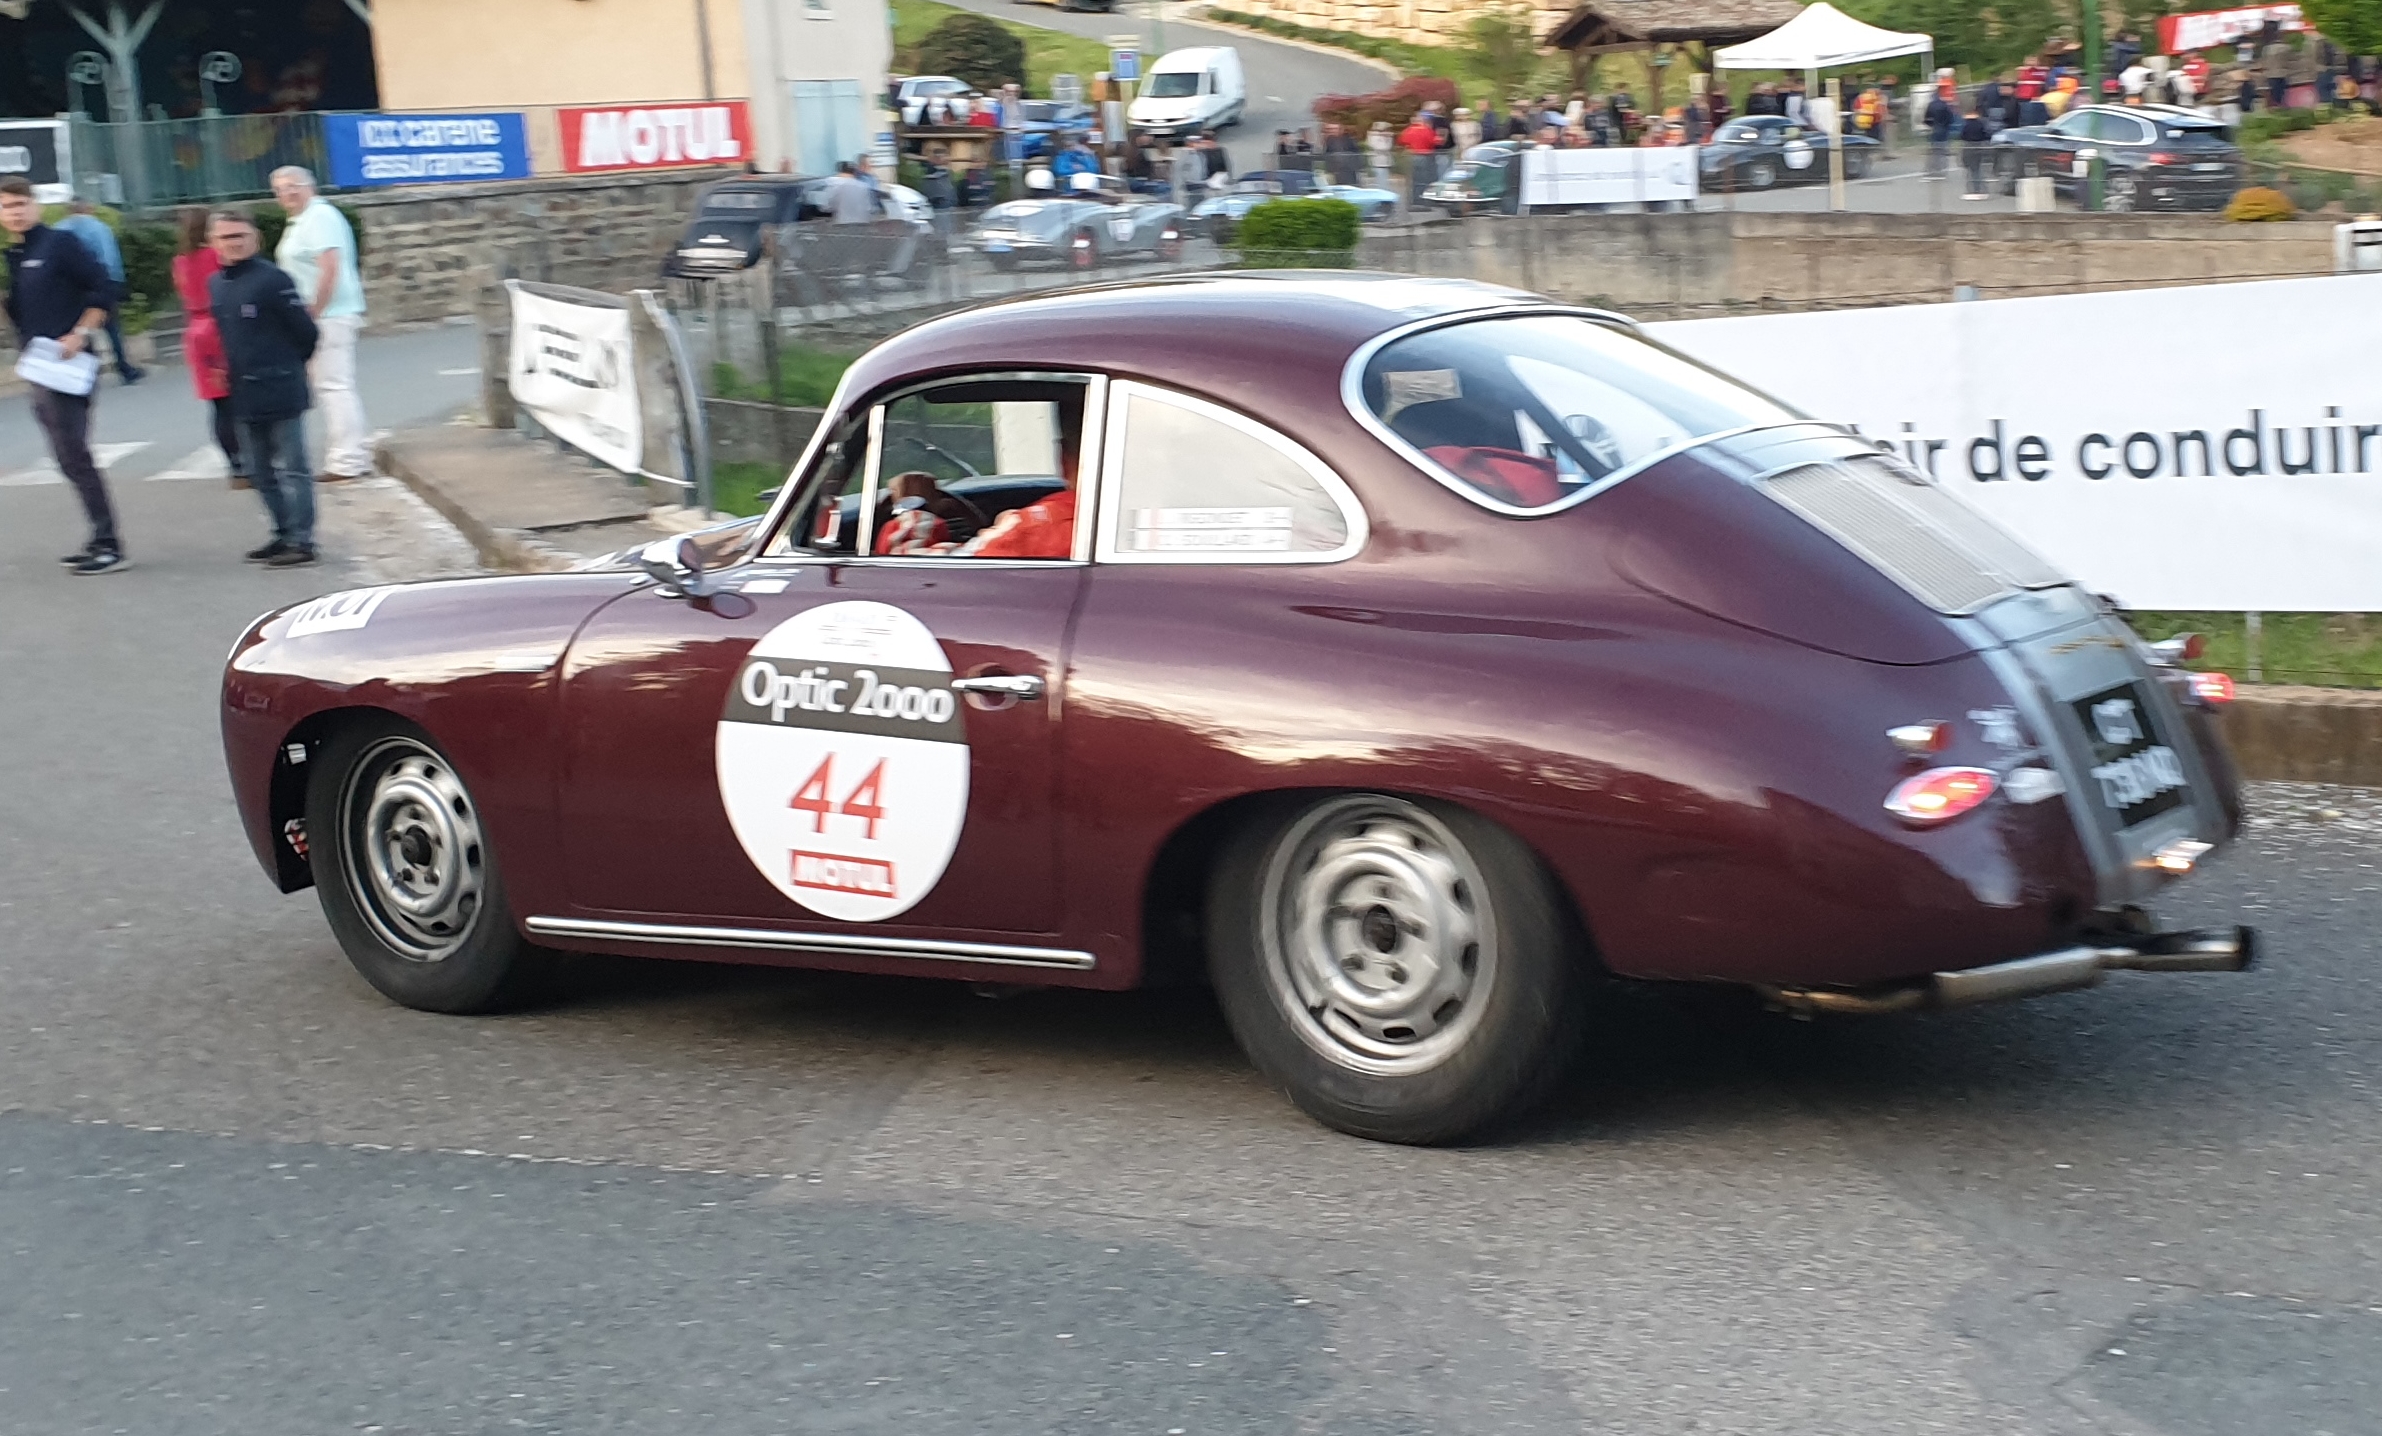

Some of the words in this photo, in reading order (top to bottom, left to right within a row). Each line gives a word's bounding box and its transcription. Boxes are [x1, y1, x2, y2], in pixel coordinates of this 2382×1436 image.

[578, 106, 741, 167] MOTUL
[1961, 418, 2053, 483] de
[2074, 404, 2382, 480] conduir
[741, 660, 849, 723] Optic
[850, 668, 955, 724] 2000
[787, 751, 890, 840] 44
[793, 852, 897, 893] MOTUL
